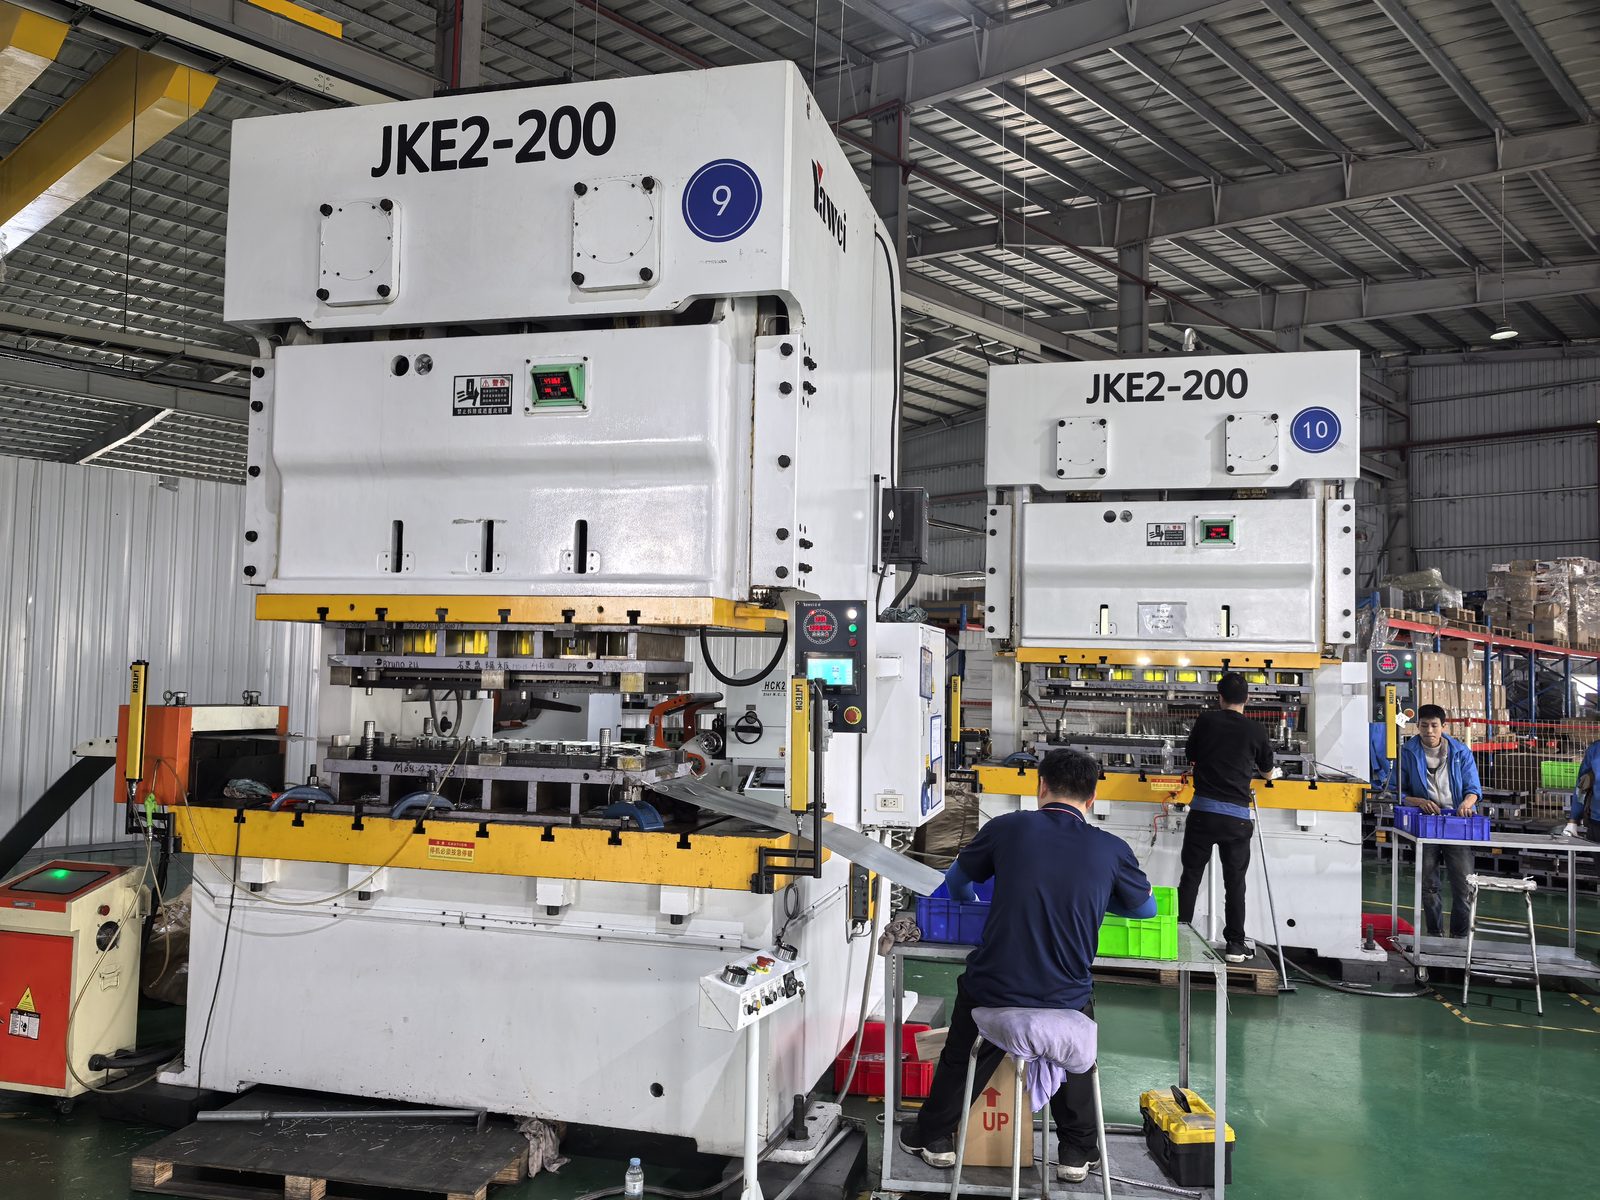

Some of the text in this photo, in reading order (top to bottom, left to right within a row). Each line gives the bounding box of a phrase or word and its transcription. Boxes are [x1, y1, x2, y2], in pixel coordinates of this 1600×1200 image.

[371, 101, 617, 178] JKE2-200
[712, 184, 732, 217] 9
[811, 158, 847, 253] Yawei
[1086, 368, 1249, 404] JKE2-200
[1303, 420, 1328, 439] 10
[983, 1112, 1009, 1132] UP
